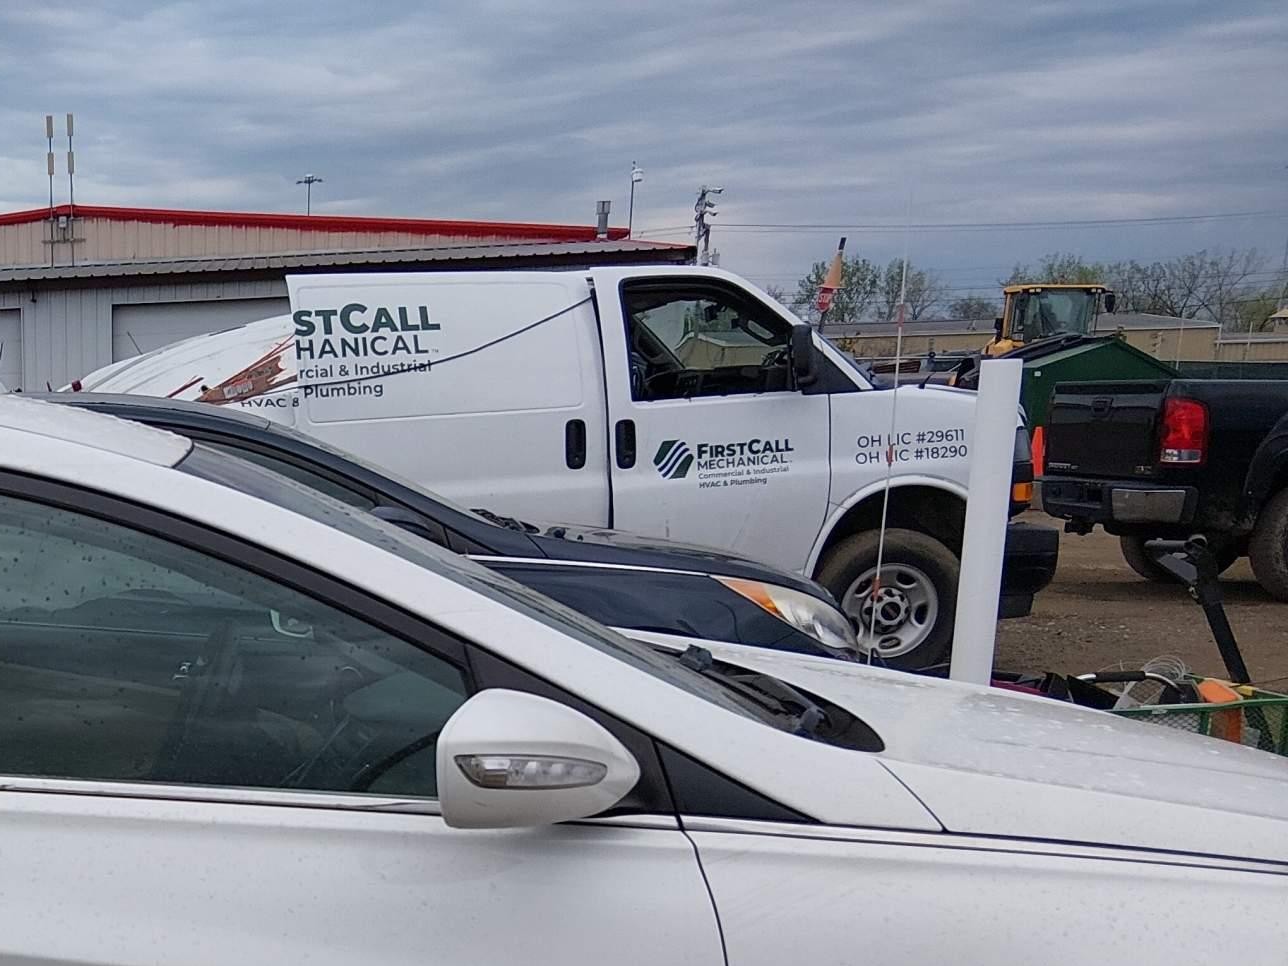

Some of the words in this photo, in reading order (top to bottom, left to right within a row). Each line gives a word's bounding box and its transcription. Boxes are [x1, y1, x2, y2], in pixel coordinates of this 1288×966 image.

[296, 335, 429, 360] HANICAL
[299, 363, 333, 379] rcial
[338, 364, 349, 377] &
[355, 360, 432, 376] Industrial
[304, 382, 384, 399] Plumbing
[857, 434, 882, 448] OH
[887, 432, 912, 446] LIC
[915, 428, 965, 444] #29611
[697, 454, 788, 471] MECHANICAL
[855, 451, 880, 464] OH
[914, 445, 967, 460] #18290
[698, 468, 744, 480] Commercial
[753, 466, 789, 475] Industrial
[698, 480, 721, 489] HVAC
[730, 477, 768, 486] Plumbing
